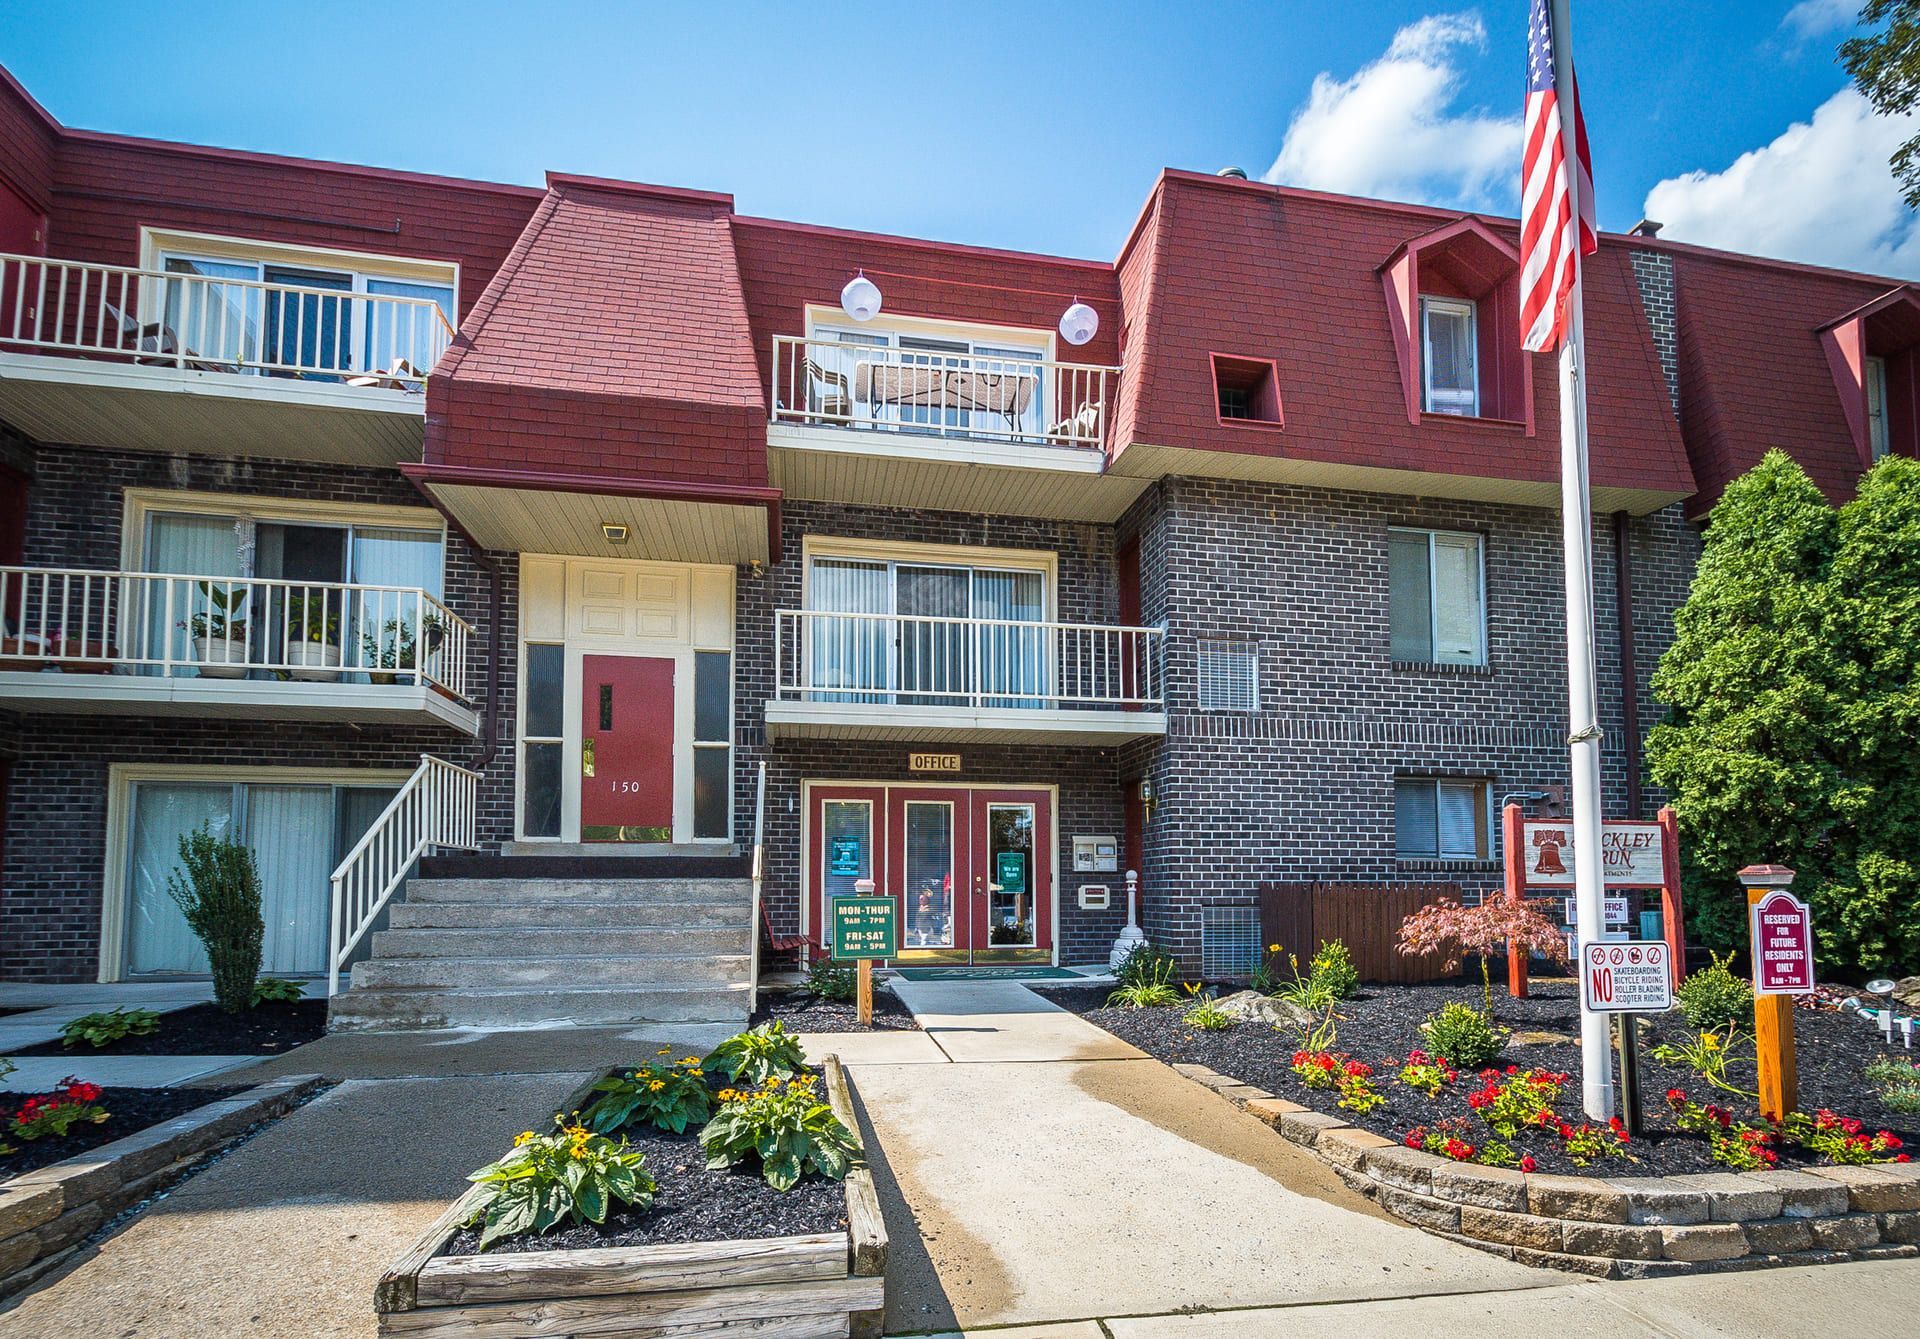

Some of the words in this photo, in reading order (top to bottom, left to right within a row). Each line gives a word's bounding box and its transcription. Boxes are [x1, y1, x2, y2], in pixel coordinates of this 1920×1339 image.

[915, 755, 957, 769] OFFICE
[612, 781, 639, 792] 150
[1601, 832, 1655, 851] CKLEY
[838, 905, 890, 915] MON-THUR
[1604, 902, 1623, 911] FFICE
[1764, 915, 1800, 925] RESERVED
[845, 931, 884, 941] FRI-SAT
[1777, 927, 1789, 935] FOR
[1770, 938, 1797, 947] FUTURE
[1765, 950, 1804, 960] RESIDENTS
[1613, 966, 1661, 975] SKATEBOARDING
[1776, 963, 1794, 973] ONLY
[1592, 967, 1612, 1003] NO
[1614, 976, 1639, 985] BICYCLE
[1641, 976, 1663, 984] RIDING
[1615, 985, 1637, 994] ROLLER
[1638, 985, 1664, 993] BLADING
[1615, 994, 1642, 1003] SCOOTER
[1643, 994, 1665, 1002] RIDING
